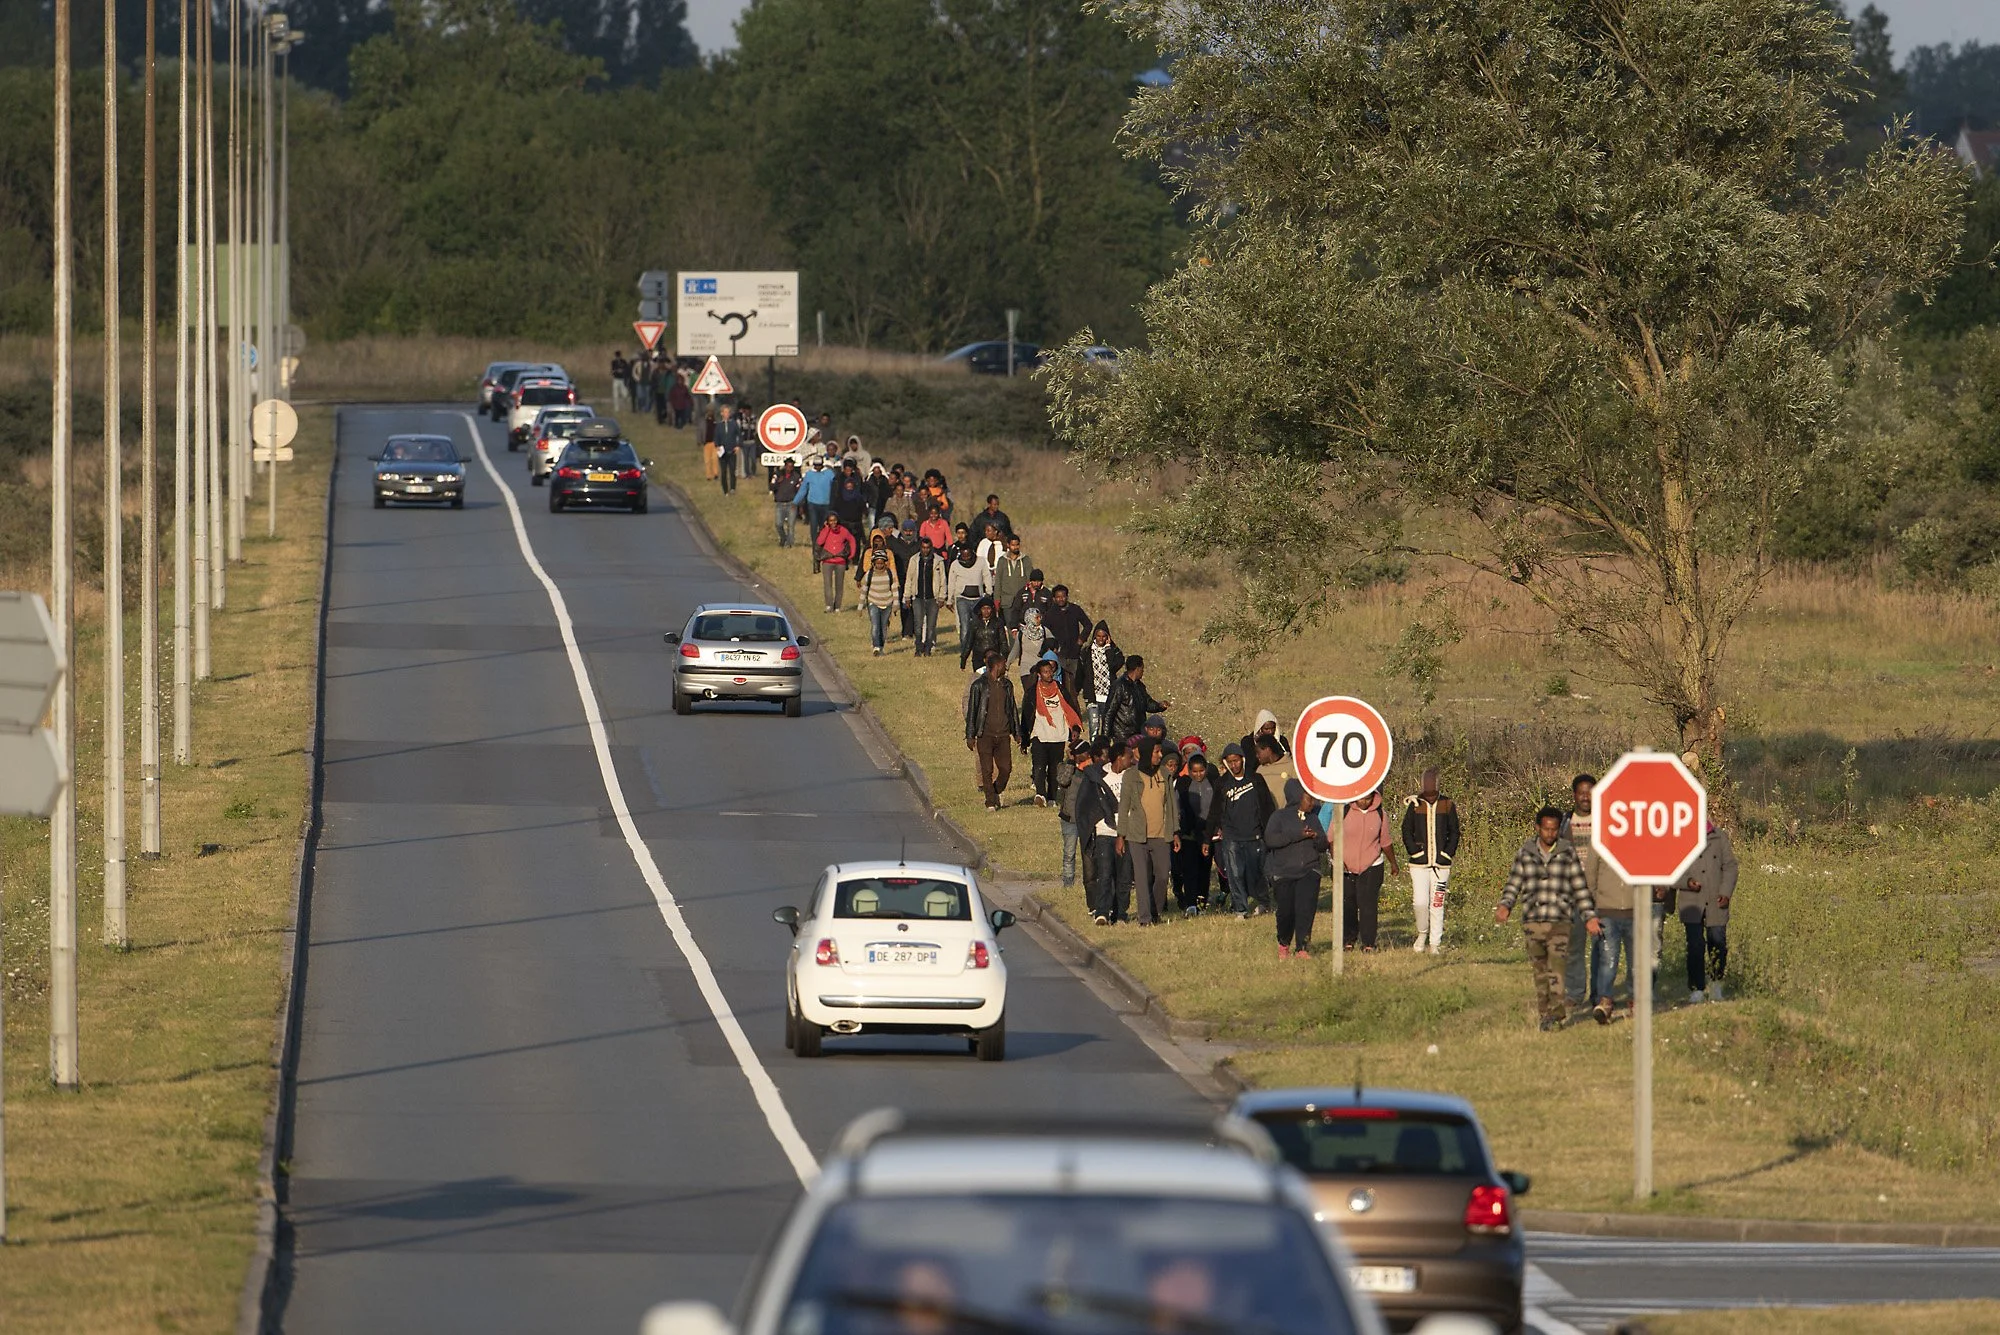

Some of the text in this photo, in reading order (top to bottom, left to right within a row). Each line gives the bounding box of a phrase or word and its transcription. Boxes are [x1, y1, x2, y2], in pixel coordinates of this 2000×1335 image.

[763, 455, 798, 464] RAPPL
[1316, 732, 1367, 768] 70
[1607, 800, 1693, 837] STOP
[1433, 881, 1447, 908] YMCMB
